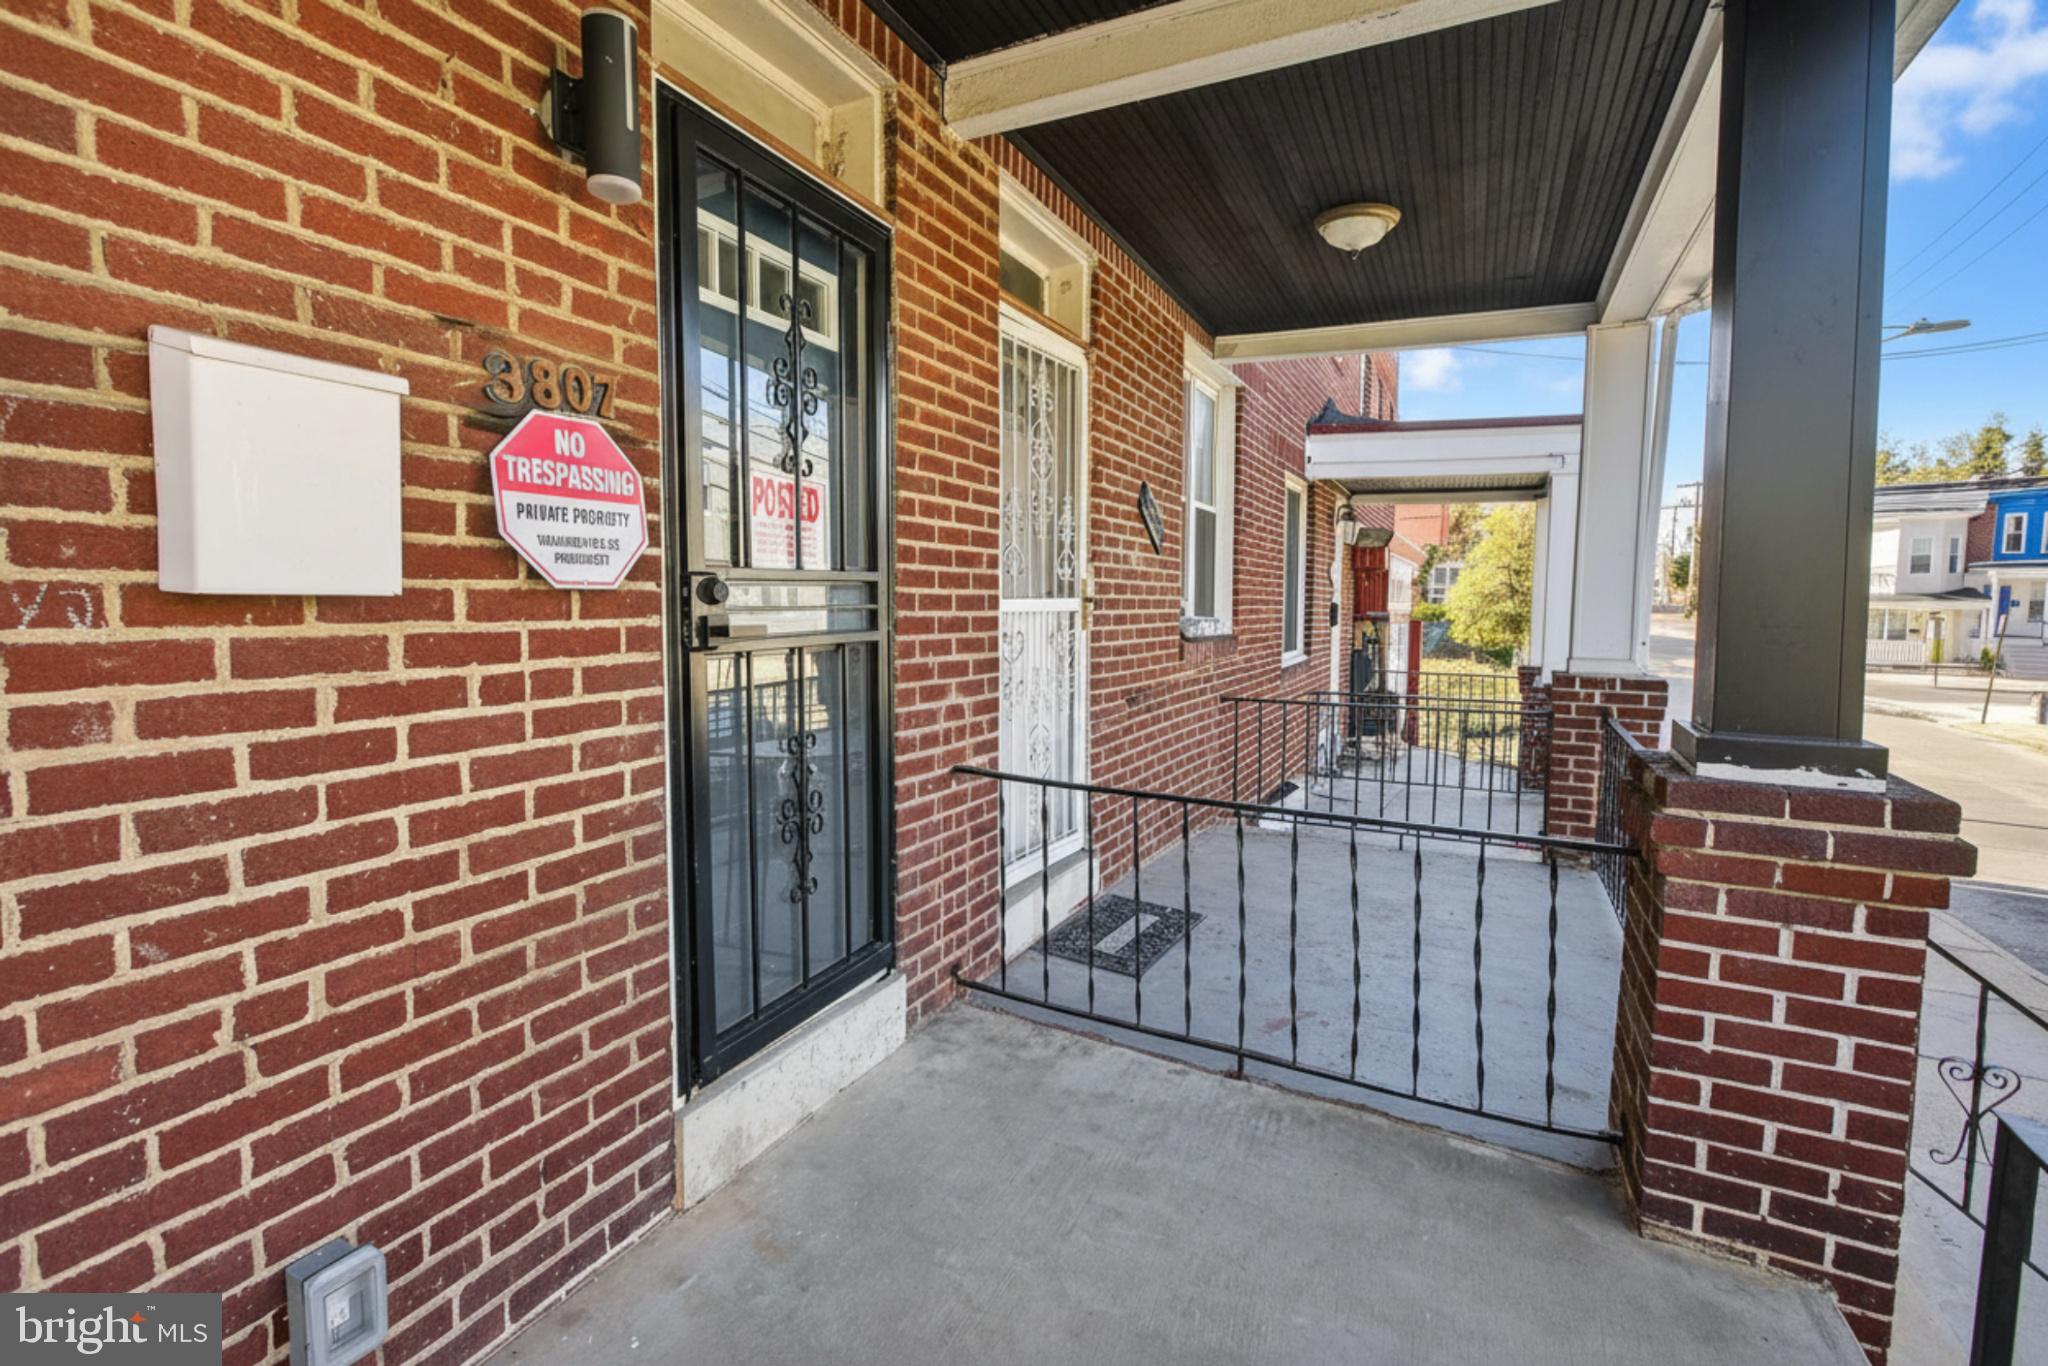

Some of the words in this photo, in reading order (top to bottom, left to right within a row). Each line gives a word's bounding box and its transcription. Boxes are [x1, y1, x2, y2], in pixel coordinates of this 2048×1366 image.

[484, 352, 620, 419] 3807
[554, 428, 585, 458] NO
[501, 454, 634, 496] TRESPASSING
